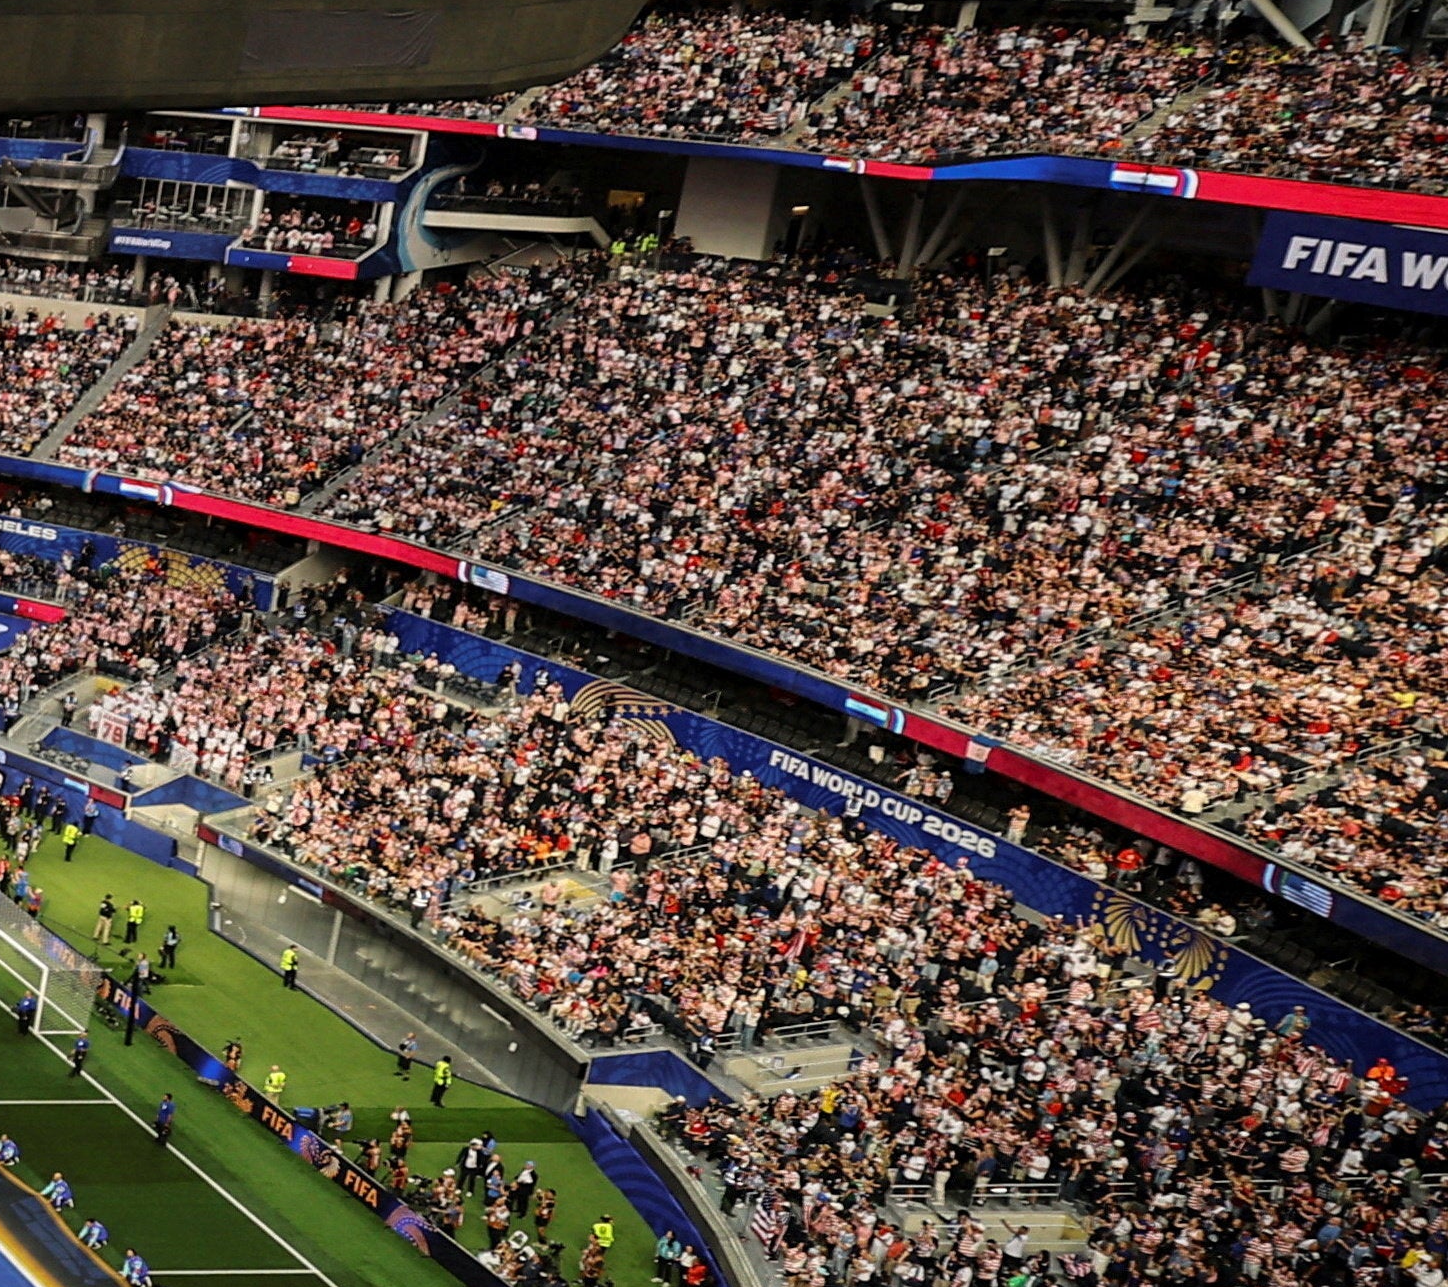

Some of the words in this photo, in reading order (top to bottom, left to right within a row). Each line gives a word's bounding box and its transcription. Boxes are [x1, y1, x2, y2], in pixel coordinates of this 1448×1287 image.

[1282, 235, 1388, 283] FIFA
[1402, 251, 1448, 290] W
[769, 749, 809, 780] FIFA
[881, 798, 923, 824] CUP
[922, 815, 997, 858] 2026
[262, 1106, 293, 1141] FIFA
[344, 1169, 378, 1208] FIFA
